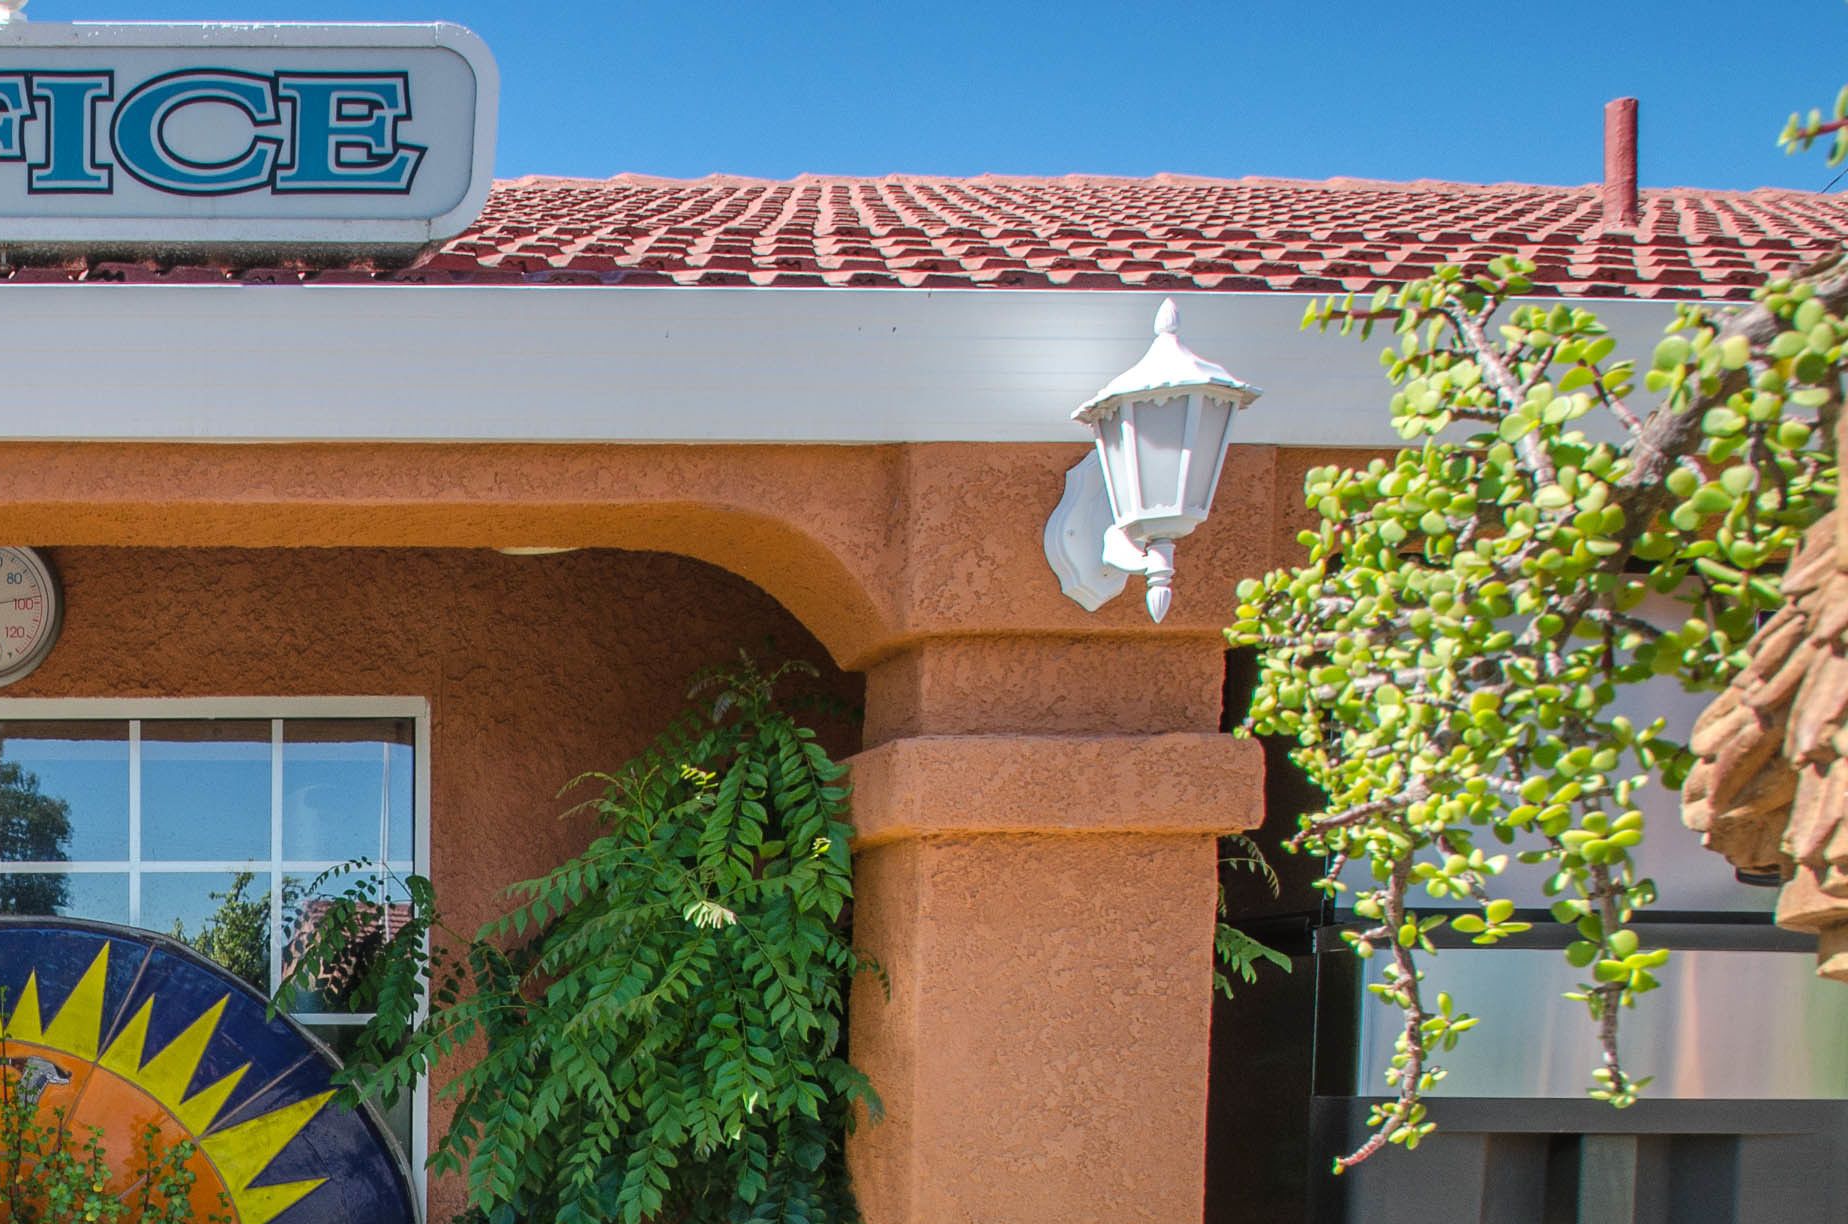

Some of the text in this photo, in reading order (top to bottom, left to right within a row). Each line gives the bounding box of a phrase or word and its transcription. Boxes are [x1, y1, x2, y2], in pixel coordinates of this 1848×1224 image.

[6, 572, 23, 585] 80
[13, 597, 34, 610] 100
[5, 626, 25, 638] 120
